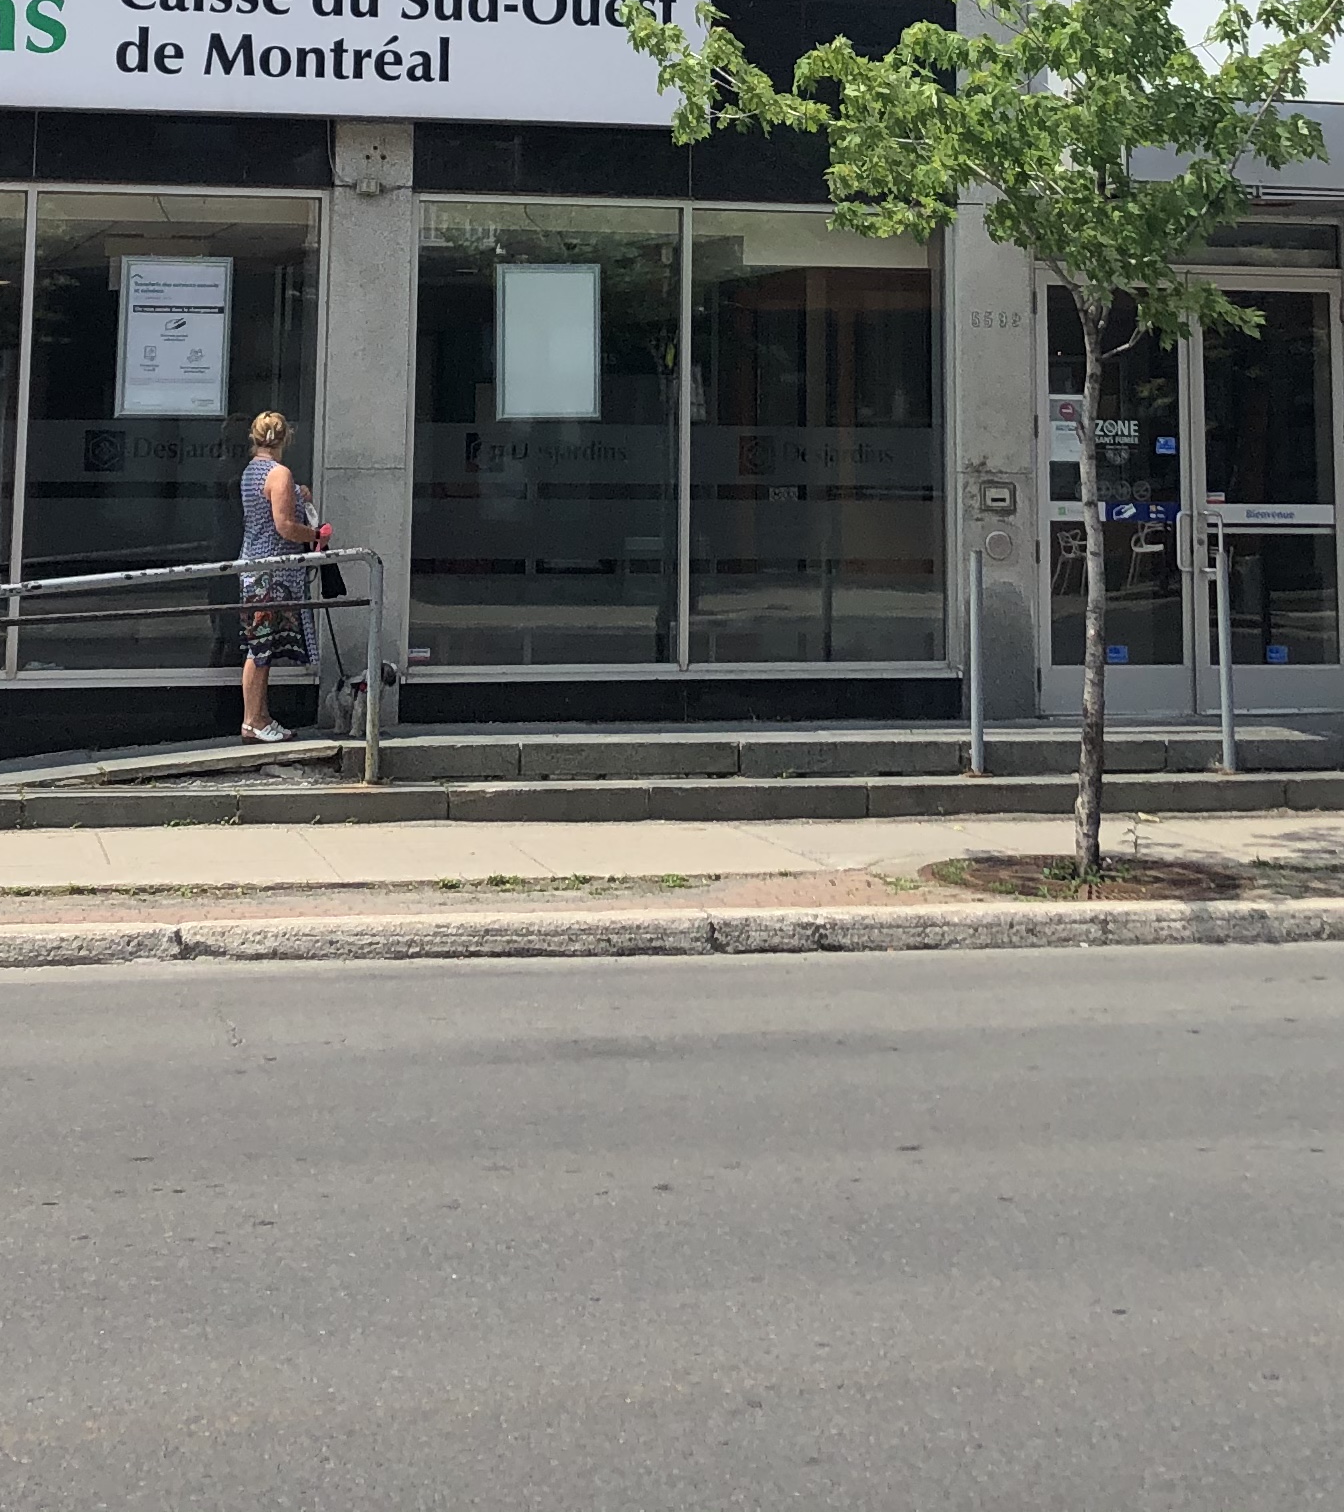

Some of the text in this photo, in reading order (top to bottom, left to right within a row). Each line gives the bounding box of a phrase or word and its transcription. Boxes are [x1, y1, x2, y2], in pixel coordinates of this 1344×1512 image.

[114, 25, 452, 83] de Montréal
[1094, 419, 1139, 436] ZONE
[133, 435, 250, 465] Desjardin
